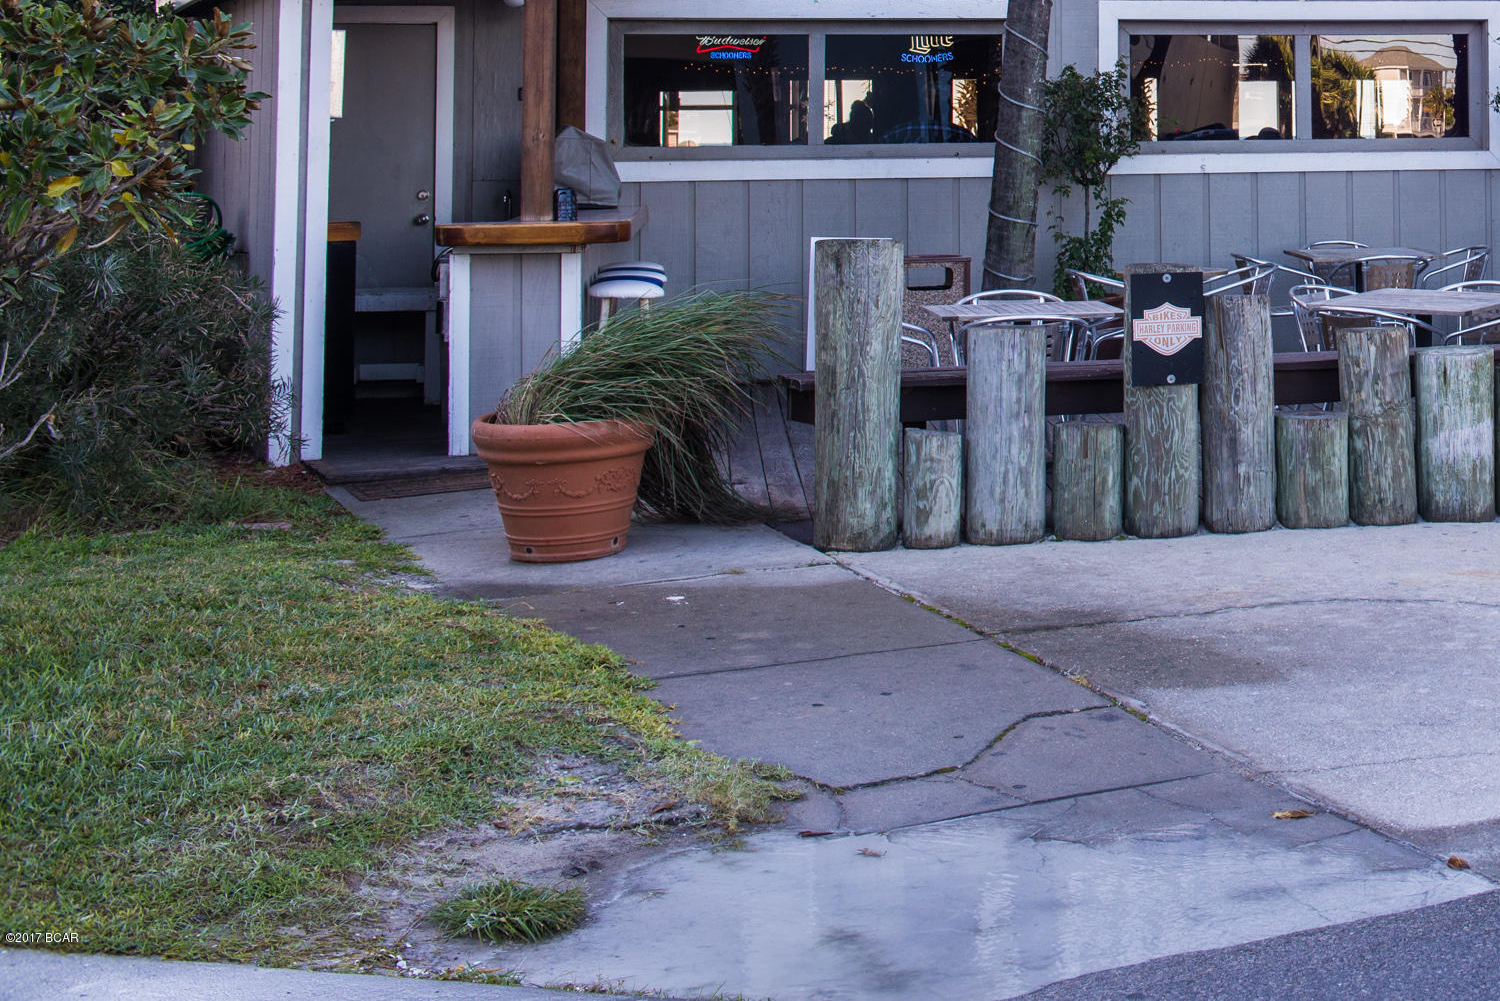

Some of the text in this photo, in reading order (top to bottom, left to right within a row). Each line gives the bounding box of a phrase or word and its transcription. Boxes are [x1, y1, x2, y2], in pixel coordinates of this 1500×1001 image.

[710, 51, 752, 60] SCHOONERS
[901, 51, 954, 63] SCHOONERS
[1152, 311, 1183, 321] BIKES
[1139, 322, 1197, 334] HARLEY PARKING
[1153, 336, 1182, 348] ONLY
